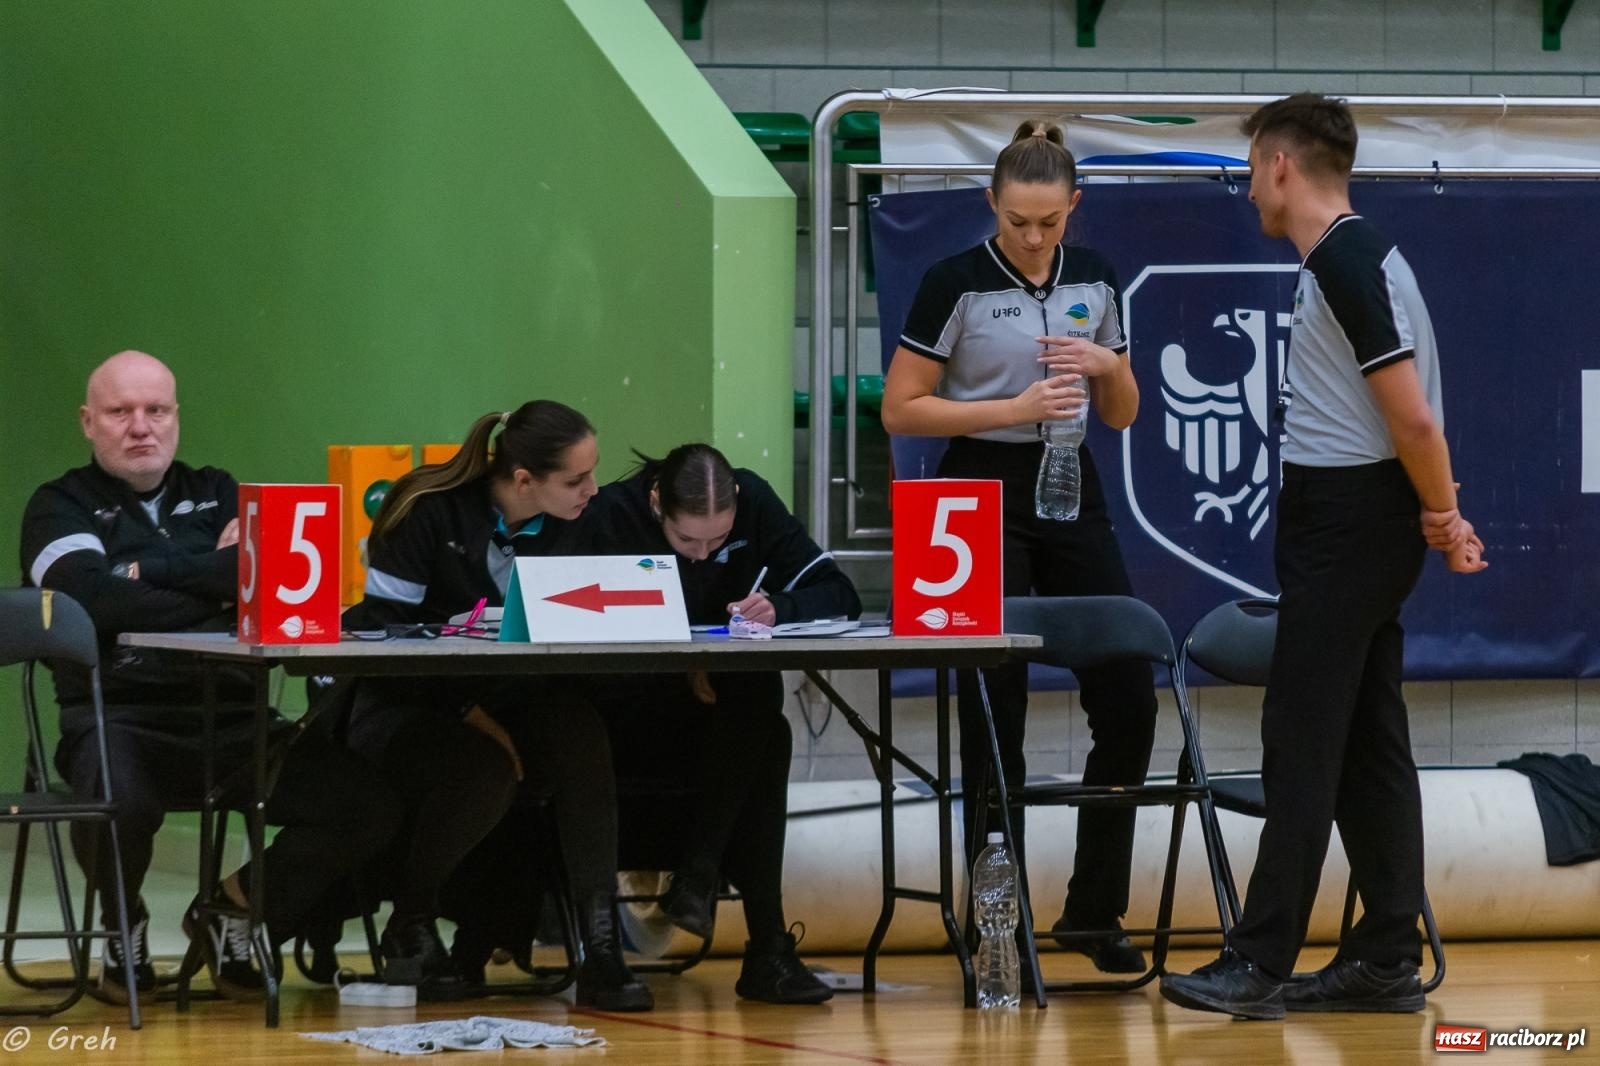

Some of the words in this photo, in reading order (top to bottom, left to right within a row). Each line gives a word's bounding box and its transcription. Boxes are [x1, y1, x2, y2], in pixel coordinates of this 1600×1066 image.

[241, 501, 258, 604] 5
[275, 501, 327, 605] 5
[912, 497, 979, 597] 5
